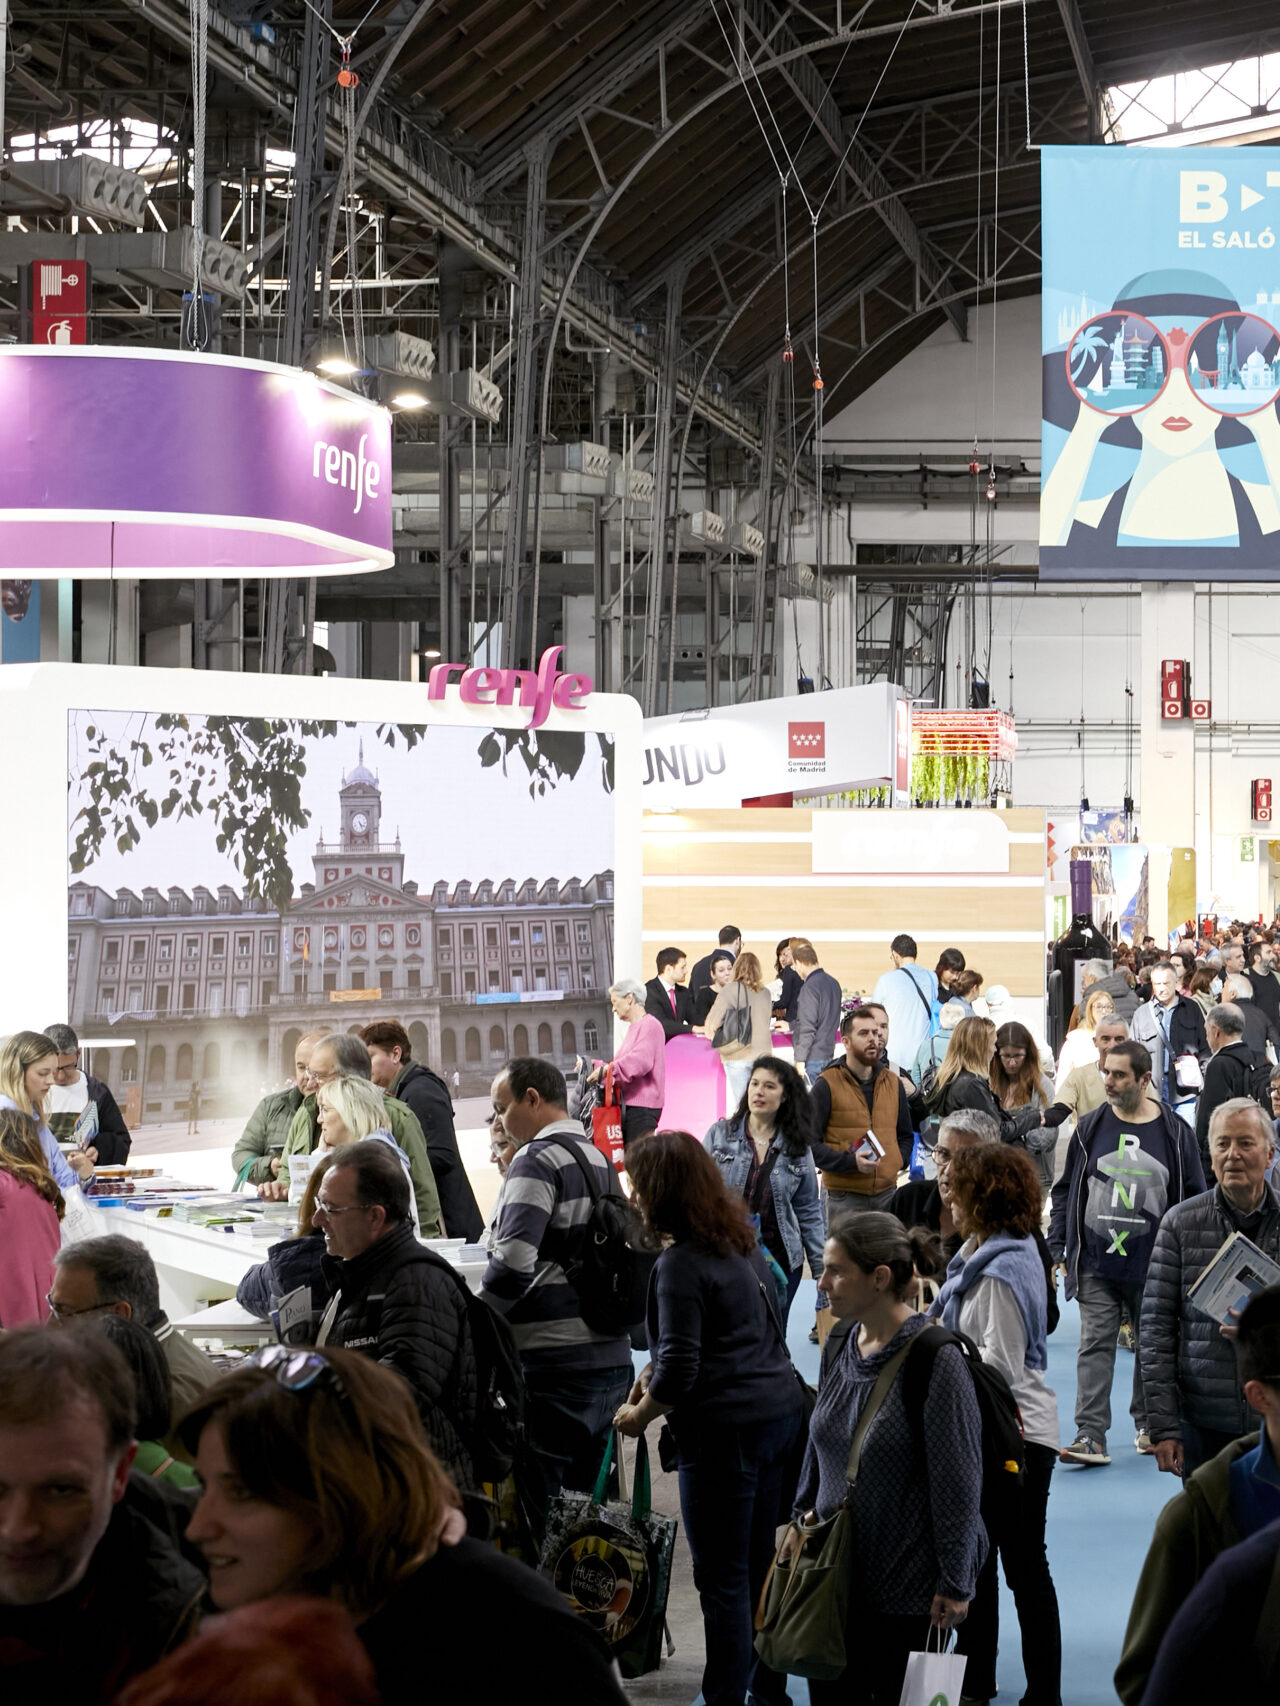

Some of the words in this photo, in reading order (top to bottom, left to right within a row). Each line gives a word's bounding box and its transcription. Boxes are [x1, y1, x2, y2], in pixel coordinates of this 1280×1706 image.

[1178, 231, 1206, 248] EL
[1212, 227, 1275, 249] SALÓ
[313, 433, 380, 514] renfe
[428, 645, 593, 729] renfe
